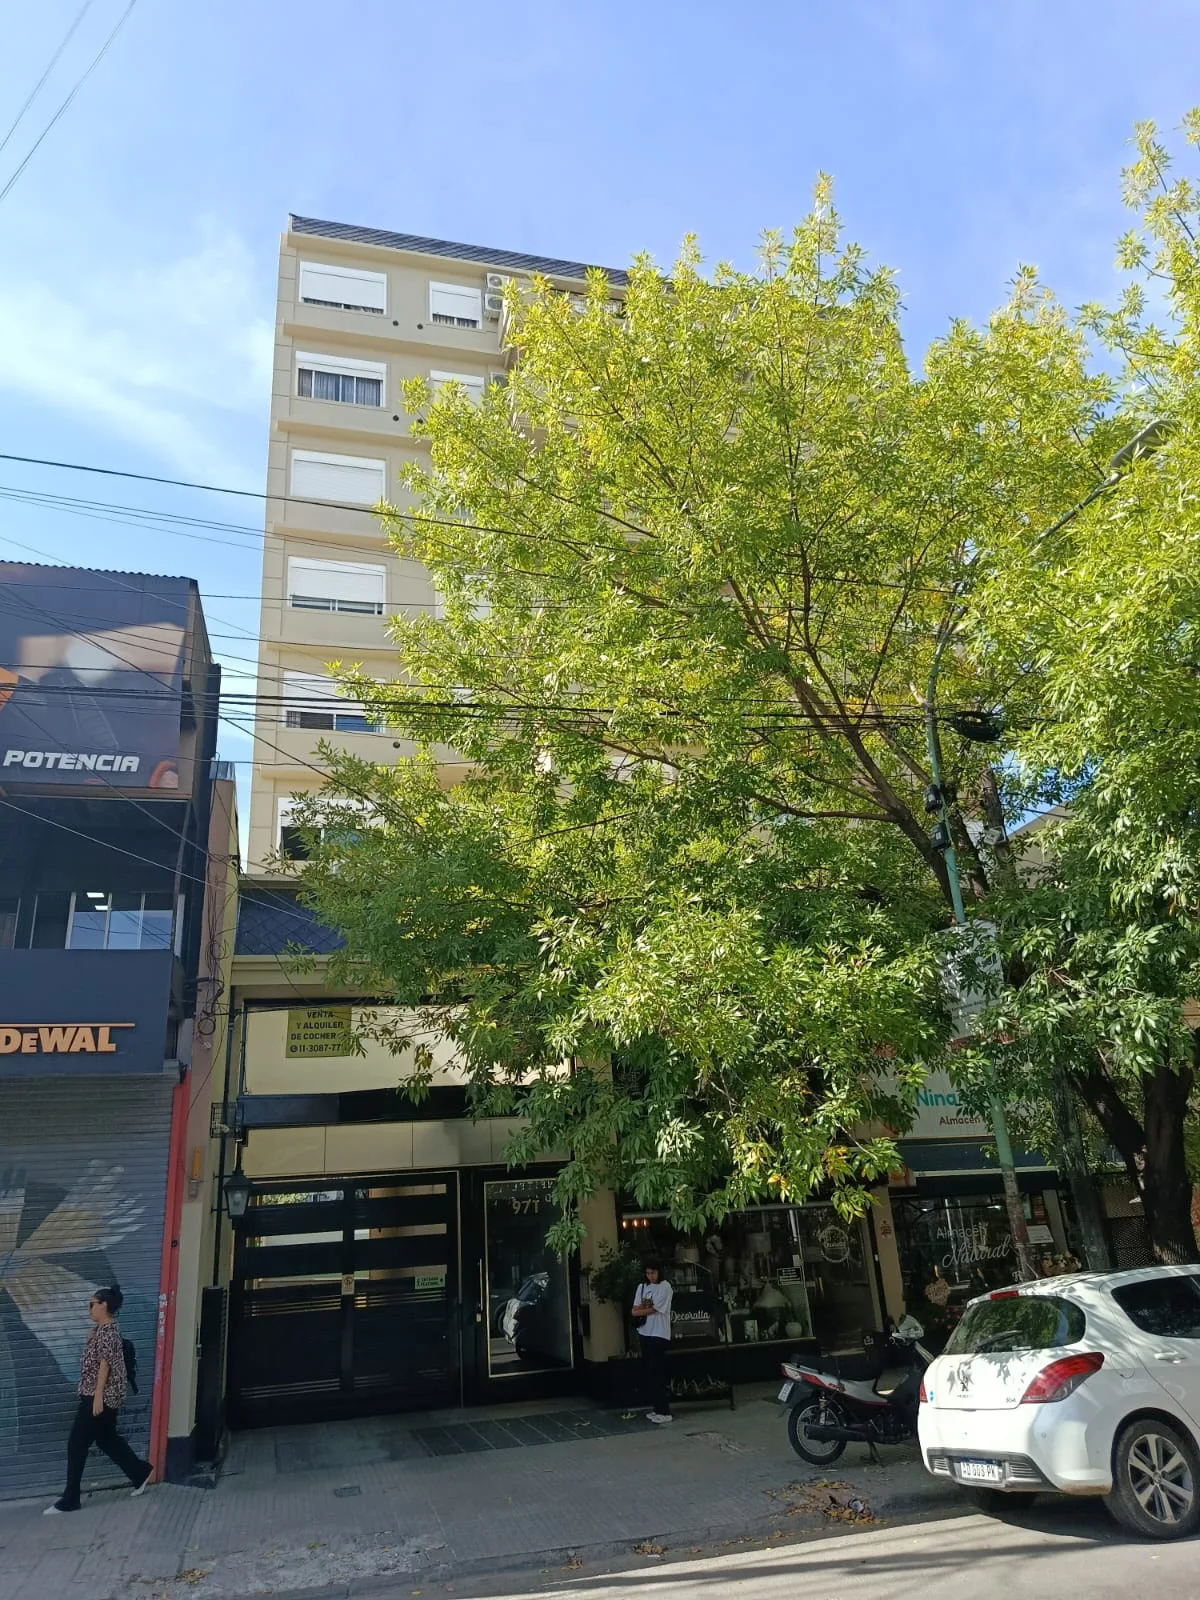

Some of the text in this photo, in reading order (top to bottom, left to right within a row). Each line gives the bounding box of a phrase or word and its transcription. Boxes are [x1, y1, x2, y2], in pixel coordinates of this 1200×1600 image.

[3, 750, 140, 772] POTENCIA
[307, 1011, 334, 1019] VENTA
[296, 1021, 344, 1030] Y ALQUILER
[916, 1089, 957, 1106] Nina
